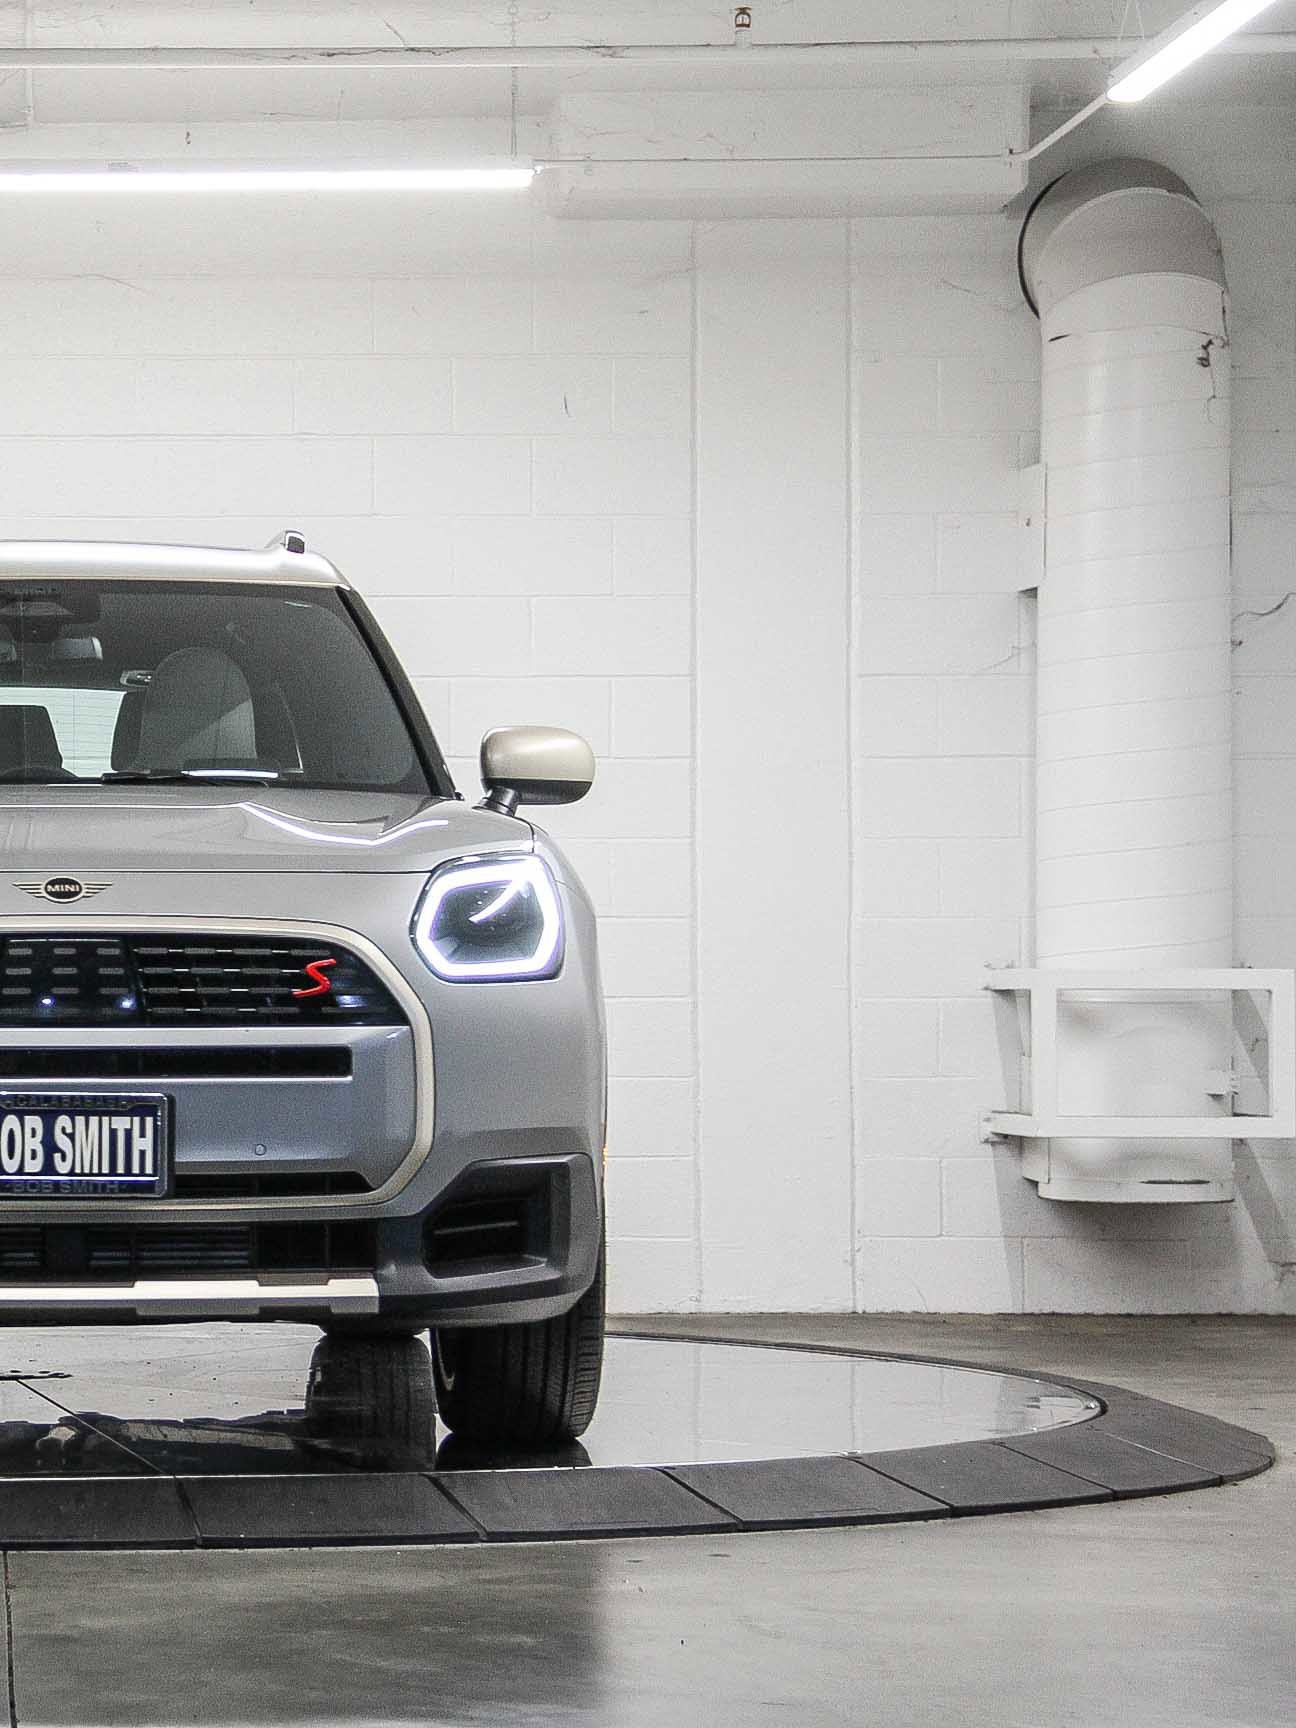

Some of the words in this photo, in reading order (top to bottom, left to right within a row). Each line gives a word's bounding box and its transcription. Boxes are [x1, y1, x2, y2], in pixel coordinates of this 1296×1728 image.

[46, 883, 80, 893] MINI
[291, 958, 337, 998] S
[52, 1114, 154, 1175] SMITH
